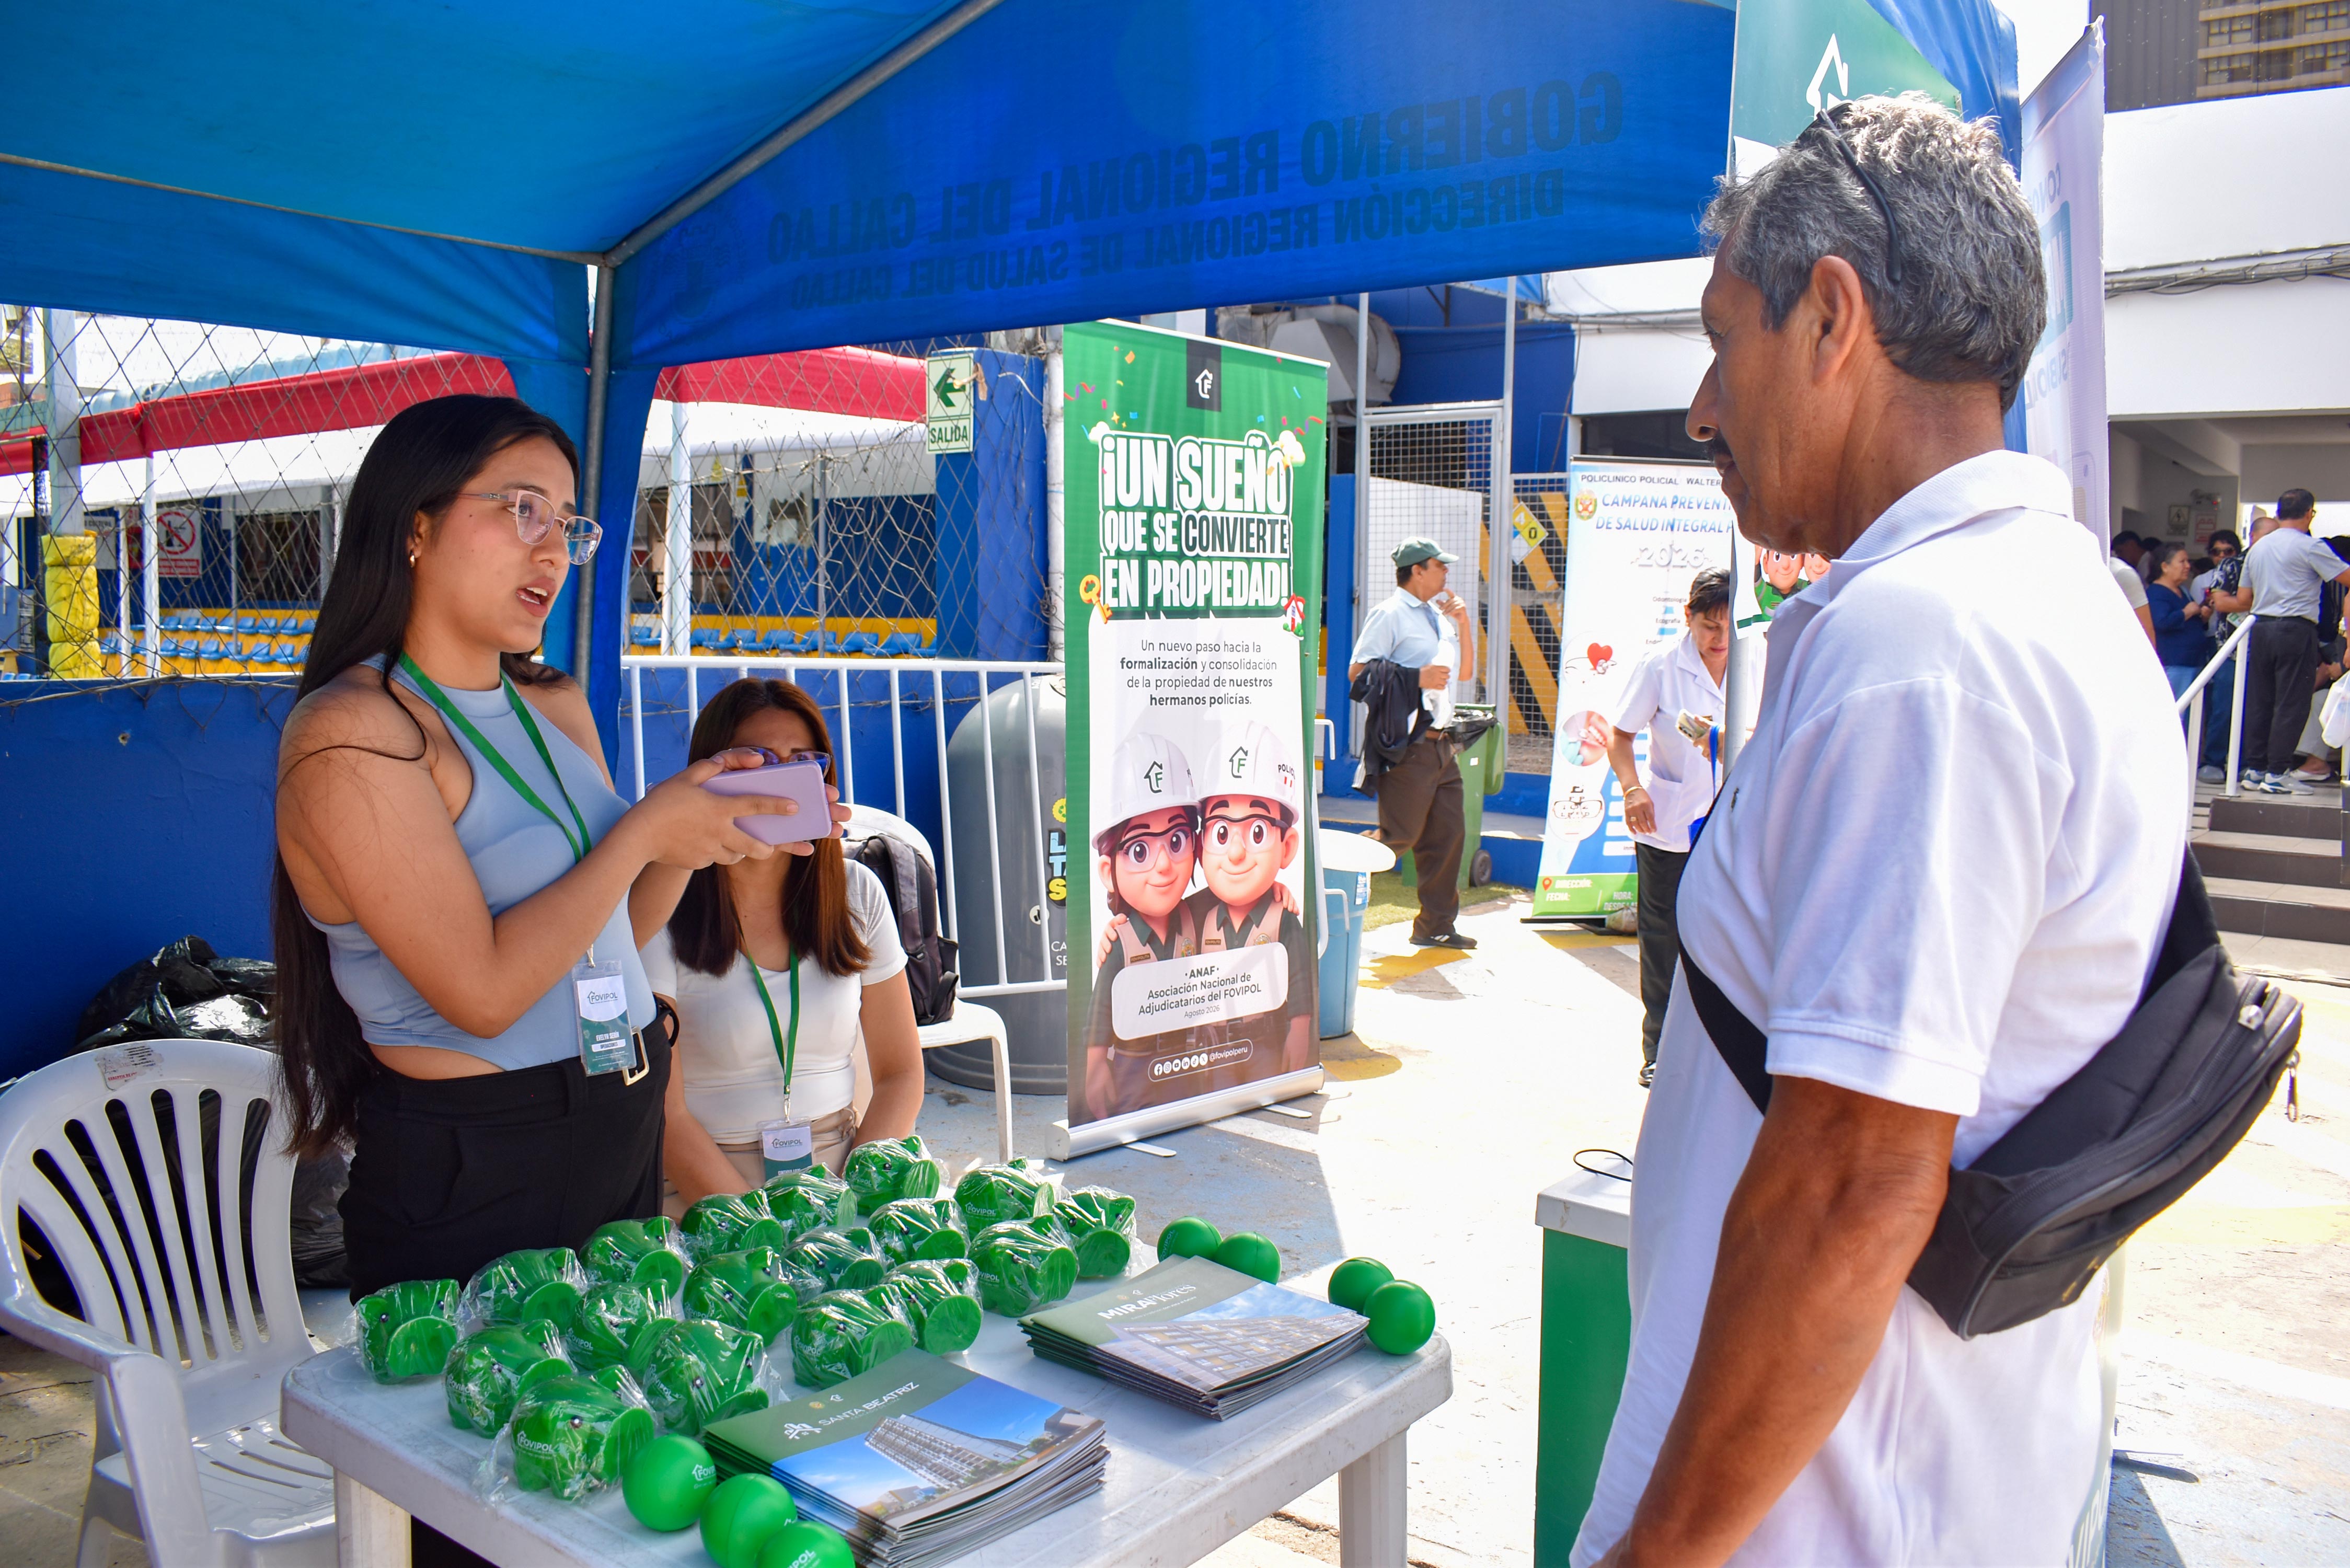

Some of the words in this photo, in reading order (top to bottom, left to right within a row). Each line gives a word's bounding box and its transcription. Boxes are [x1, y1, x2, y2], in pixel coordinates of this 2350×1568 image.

[929, 426, 967, 444] SALIDA
[1103, 436, 1167, 507] ¡UN
[1179, 436, 1287, 514] SUEÑO
[1640, 476, 1679, 485] POLICIAL
[1687, 478, 1721, 486] WALTER
[1515, 512, 1525, 525] 4
[1596, 517, 1612, 529] DE
[1616, 517, 1658, 531] SALUD
[1661, 518, 1723, 533] INTEGRAL
[1104, 510, 1147, 556] QUE
[1153, 512, 1178, 552] SE
[1185, 514, 1288, 554] CONVIERTE
[1529, 527, 1537, 539] 0
[1638, 547, 1706, 567] 2026
[1105, 559, 1139, 607] EN
[1147, 560, 1288, 607] PROPIEDAD!
[1141, 639, 1154, 651] Un
[1159, 643, 1192, 652] nuevo
[1196, 643, 1220, 654] paso
[1224, 641, 1249, 652] hacia
[1253, 642, 1261, 652] la
[1120, 657, 1197, 670] formalización
[1201, 661, 1206, 672] y
[1209, 659, 1276, 670] consolidación
[1127, 676, 1140, 687] de
[1142, 676, 1150, 687] la
[1155, 676, 1209, 690] propiedad
[1213, 676, 1227, 687] de
[1229, 677, 1272, 687] nuestros
[1150, 694, 1206, 706] hermanos
[1209, 693, 1251, 707] policías.
[1546, 892, 1570, 901] FECHA:
[1147, 983, 1197, 999] Asociación
[1201, 974, 1238, 990] Nacional
[1240, 973, 1251, 982] de
[591, 992, 618, 1002] FOVIPOL
[1138, 995, 1205, 1016] Adjudicatarios
[1207, 990, 1221, 1002] del
[1224, 984, 1262, 999] FOVIPOL
[1184, 1009, 1205, 1019] Agosto
[1206, 1005, 1220, 1013] 2026
[1209, 1046, 1248, 1062] @fovipolperu
[968, 1205, 996, 1216] FOVIPOL
[819, 1408, 866, 1425] SANTA
[862, 1381, 919, 1410] BEATRIZ
[521, 1435, 554, 1452] FOVIPOL
